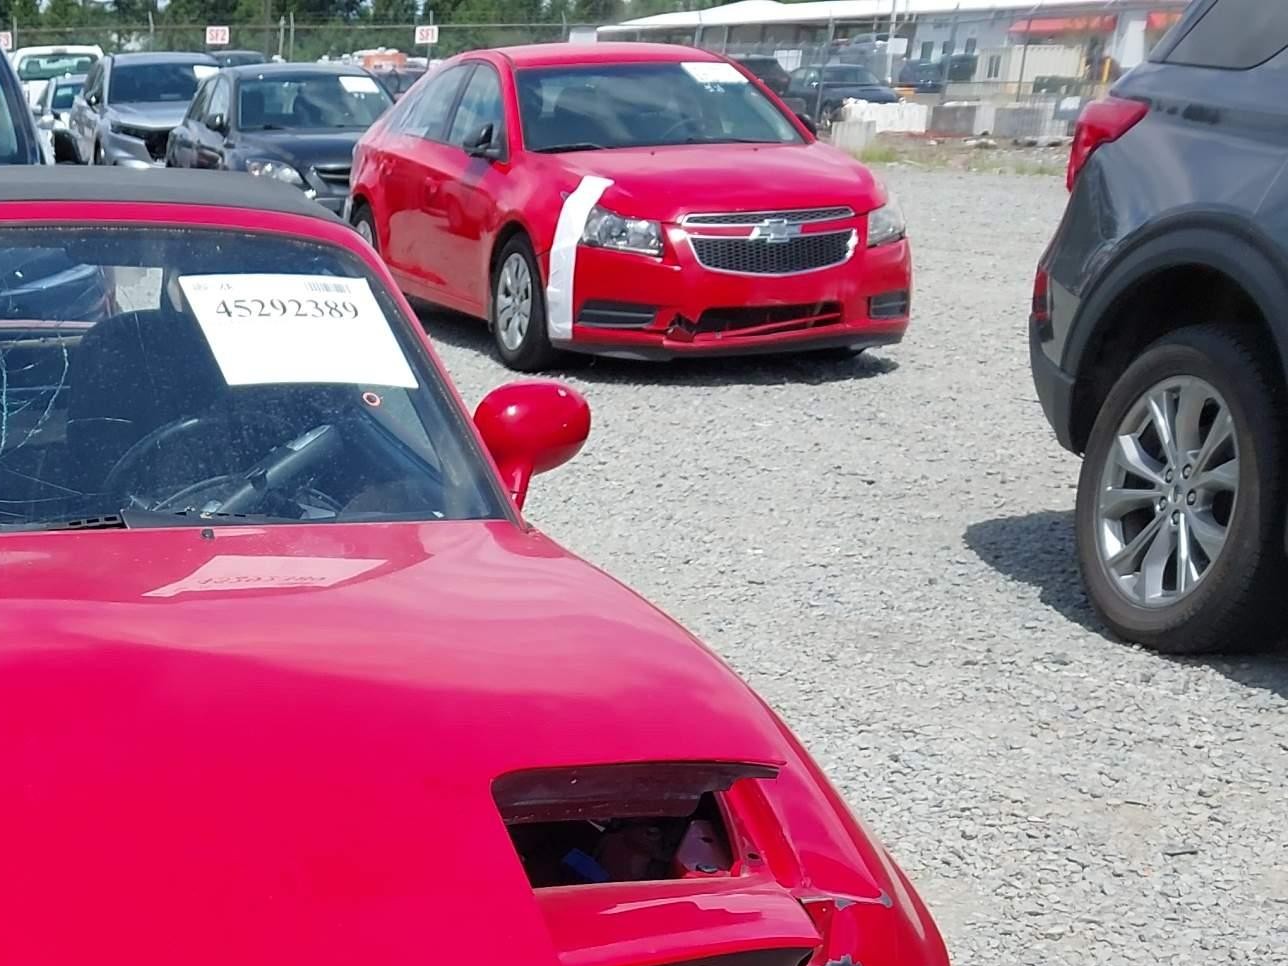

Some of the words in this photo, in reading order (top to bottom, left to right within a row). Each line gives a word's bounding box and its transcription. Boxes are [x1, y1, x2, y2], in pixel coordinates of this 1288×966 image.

[208, 28, 227, 41] SF2
[419, 28, 434, 41] SF1
[215, 298, 359, 319] 45292389
